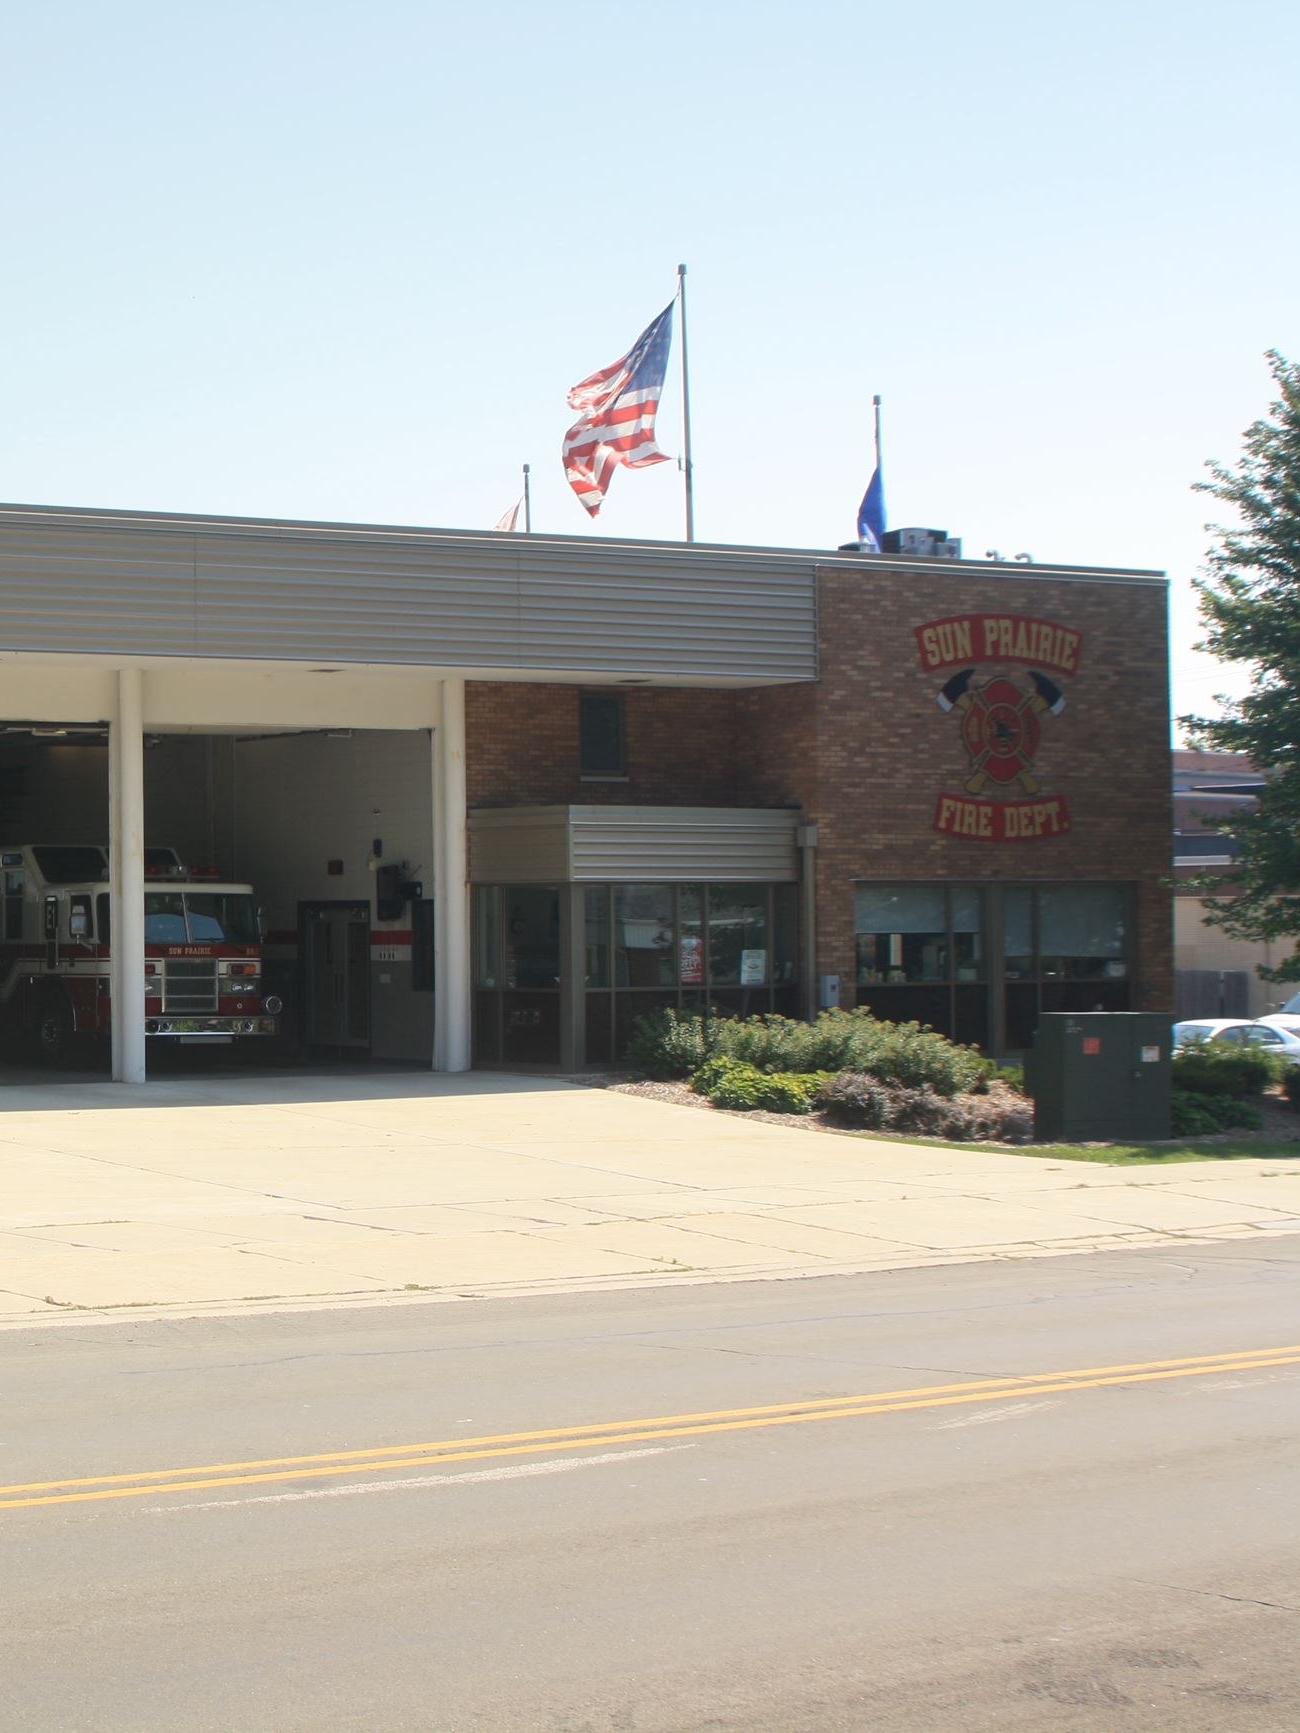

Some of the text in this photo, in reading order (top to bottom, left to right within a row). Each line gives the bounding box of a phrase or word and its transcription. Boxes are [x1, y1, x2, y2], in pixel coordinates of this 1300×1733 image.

[923, 618, 1079, 670] SUN PRAIRIE
[938, 798, 1069, 837] FIRE DEPT.
